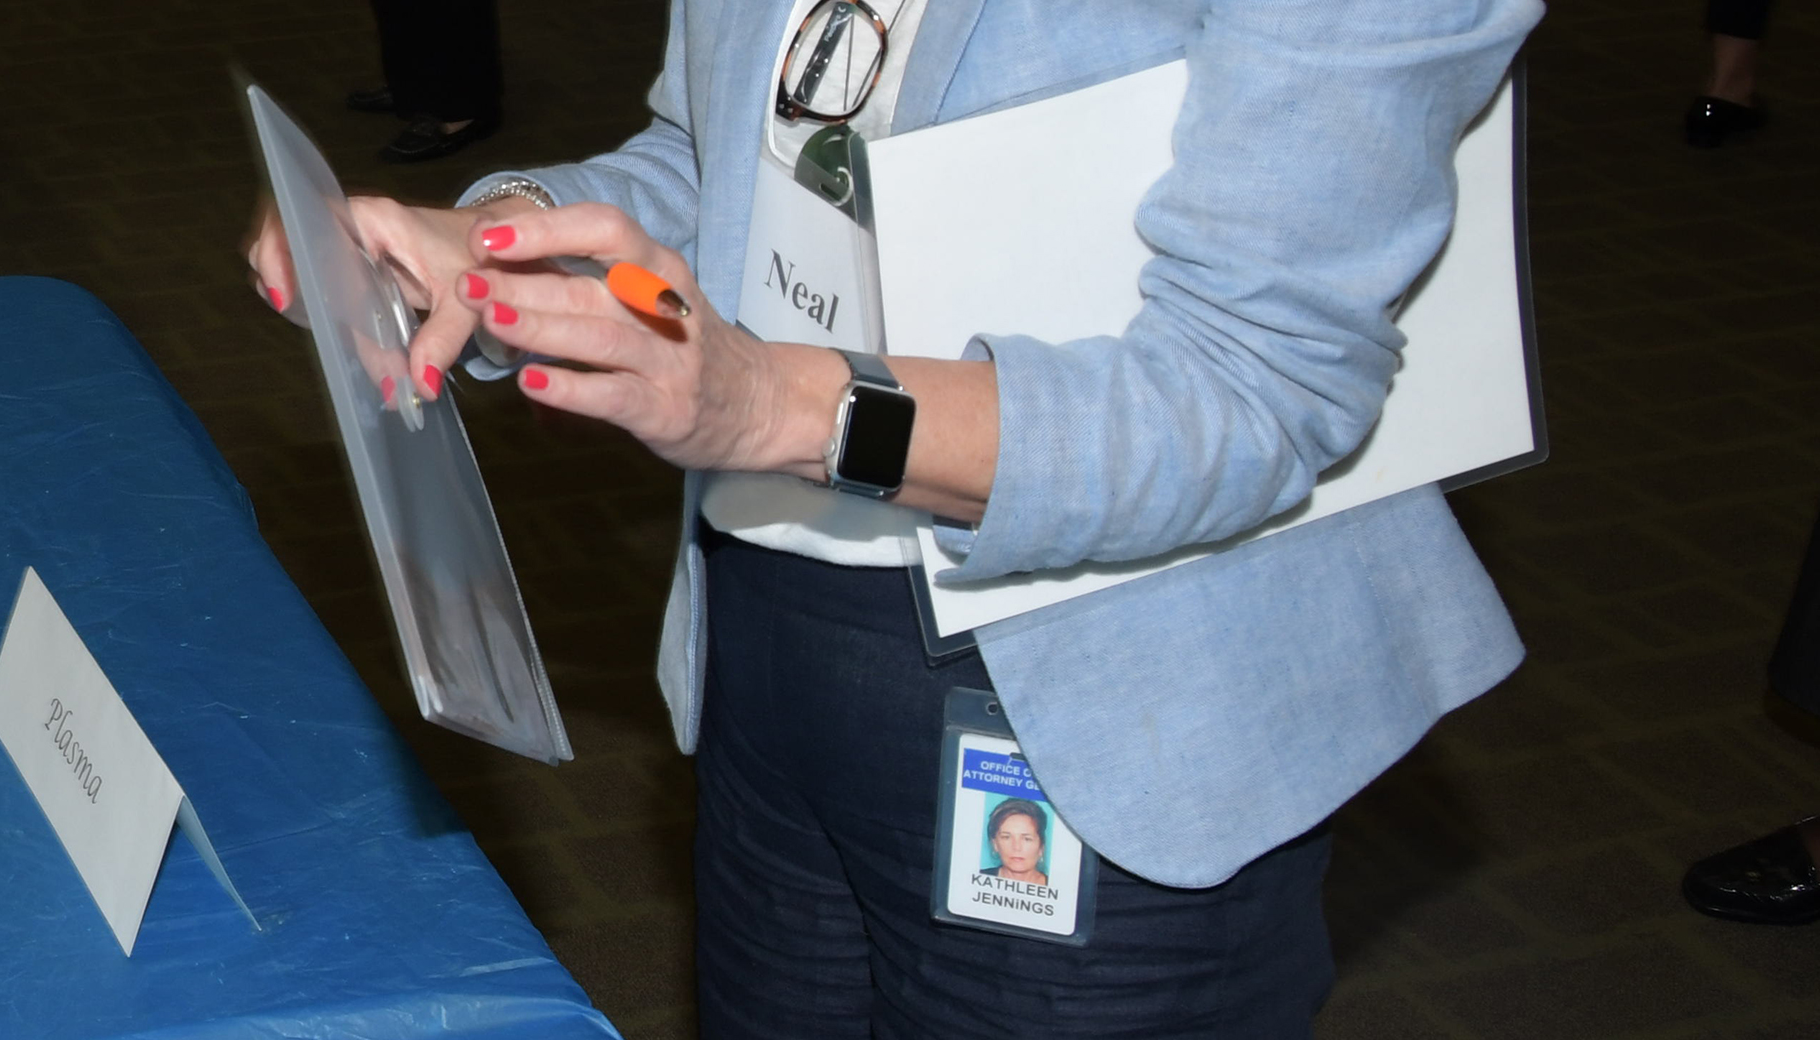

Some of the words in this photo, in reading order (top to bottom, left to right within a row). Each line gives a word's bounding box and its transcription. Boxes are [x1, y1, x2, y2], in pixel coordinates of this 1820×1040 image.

[764, 248, 839, 334] Neal
[41, 697, 104, 804] Plasma
[963, 769, 1023, 788] ATTORNEY
[980, 760, 1021, 776] OFFICE
[971, 874, 1059, 900] KATHLEEN
